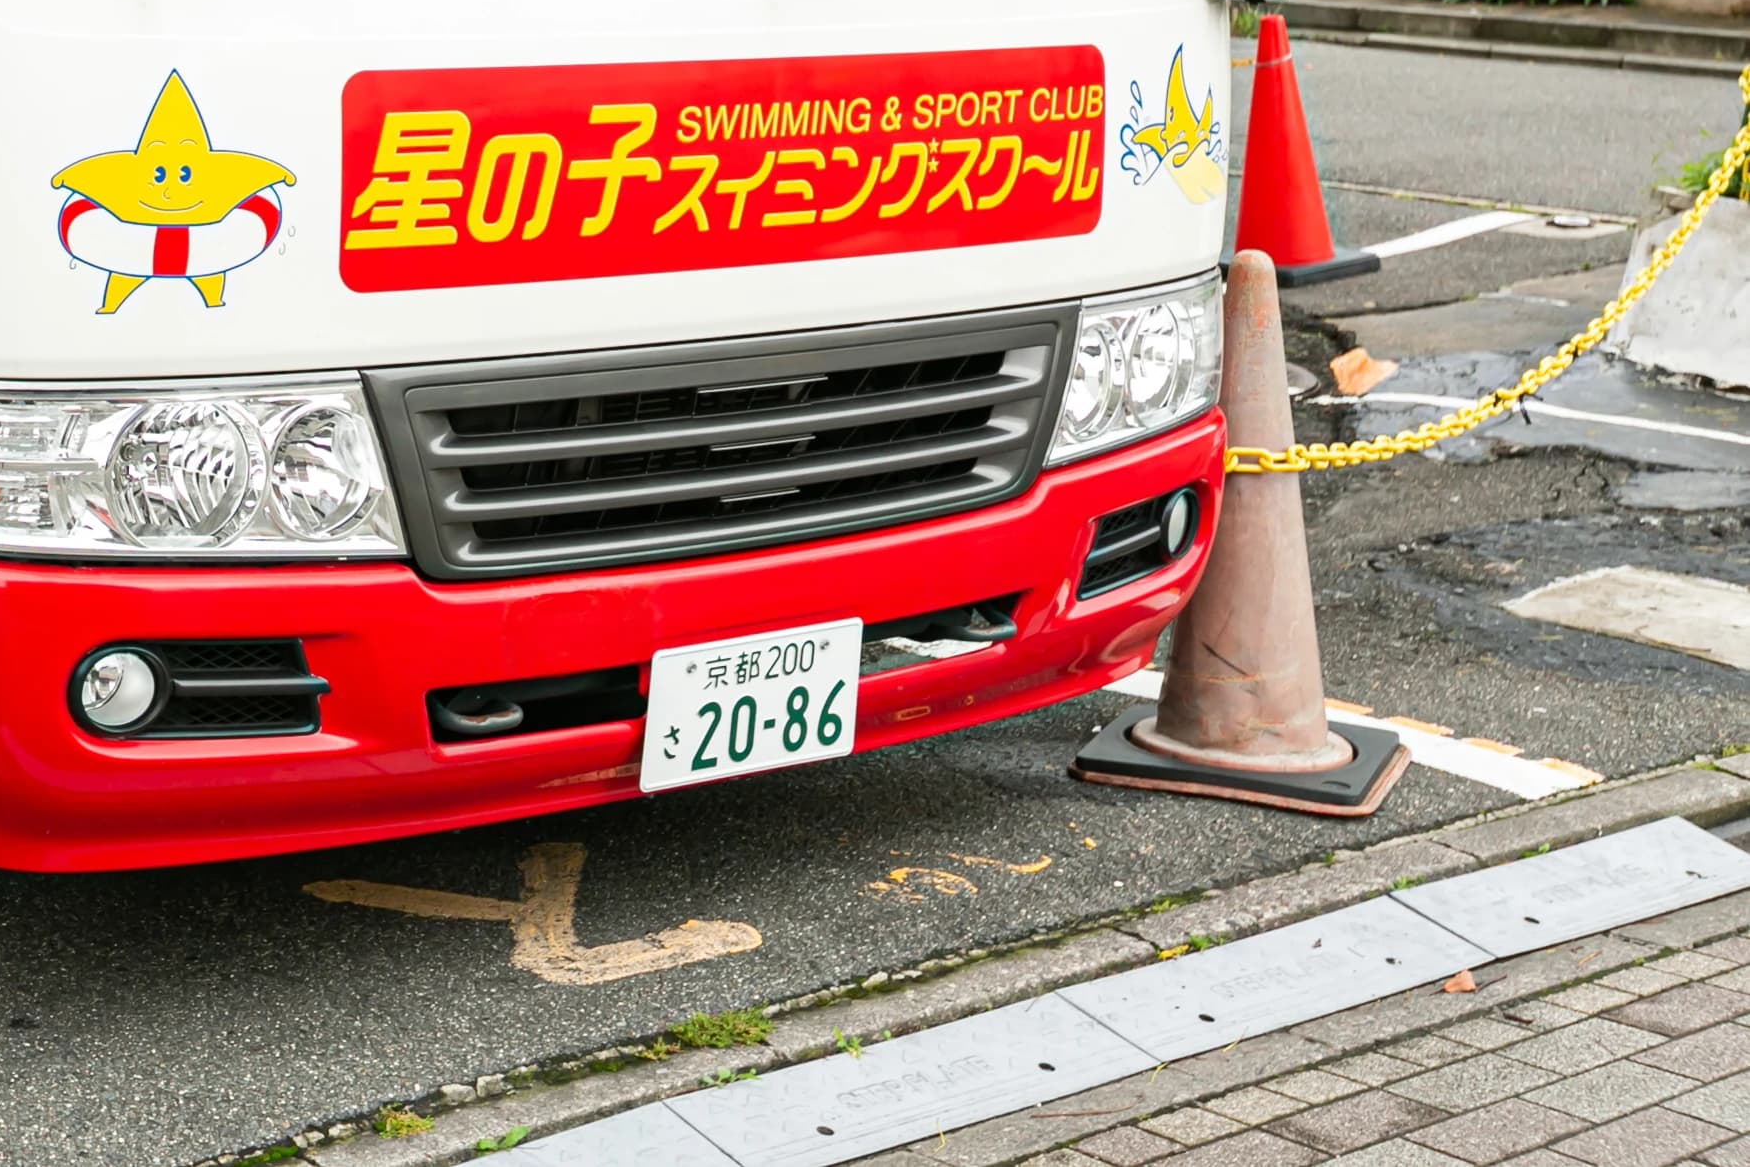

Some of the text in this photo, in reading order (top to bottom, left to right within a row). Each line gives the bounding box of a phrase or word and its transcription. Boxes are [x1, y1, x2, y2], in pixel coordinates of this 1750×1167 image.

[677, 84, 1105, 143] SWIMMING & SPORT CLUB
[663, 679, 847, 772] さ 20-86
